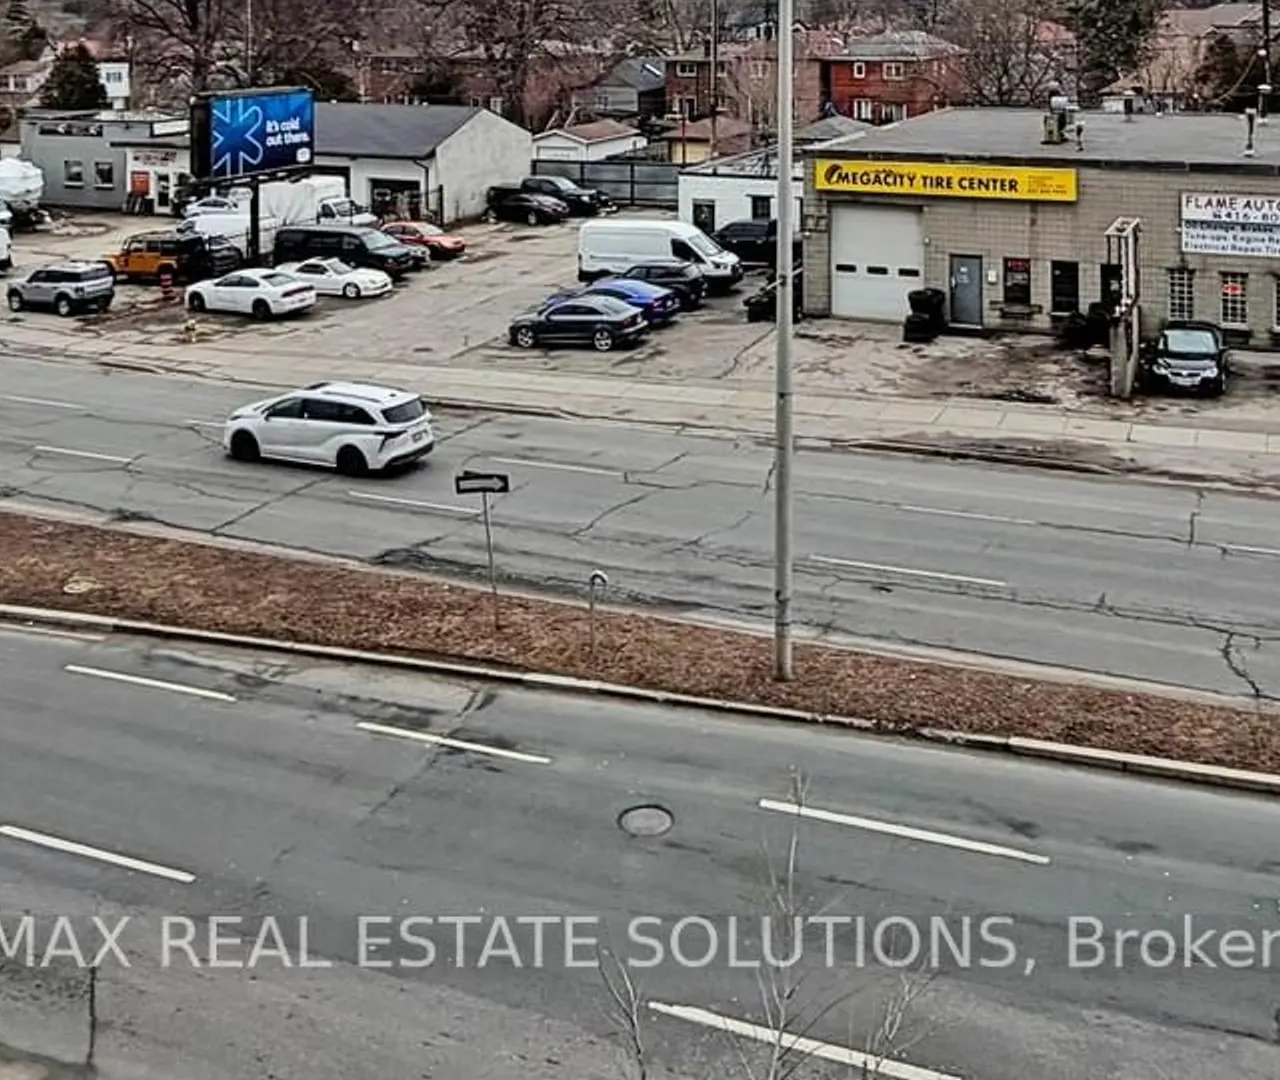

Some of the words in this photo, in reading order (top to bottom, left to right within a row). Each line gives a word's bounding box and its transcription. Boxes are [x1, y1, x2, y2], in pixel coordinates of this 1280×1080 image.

[280, 117, 300, 131] cold
[266, 134, 283, 147] out
[835, 171, 916, 188] MEGACITY
[921, 175, 954, 189] TIRE
[958, 177, 1019, 193] CENTER
[1185, 195, 1238, 210] FLAME
[1232, 234, 1266, 245] Engine
[1184, 242, 1229, 251] Electrical
